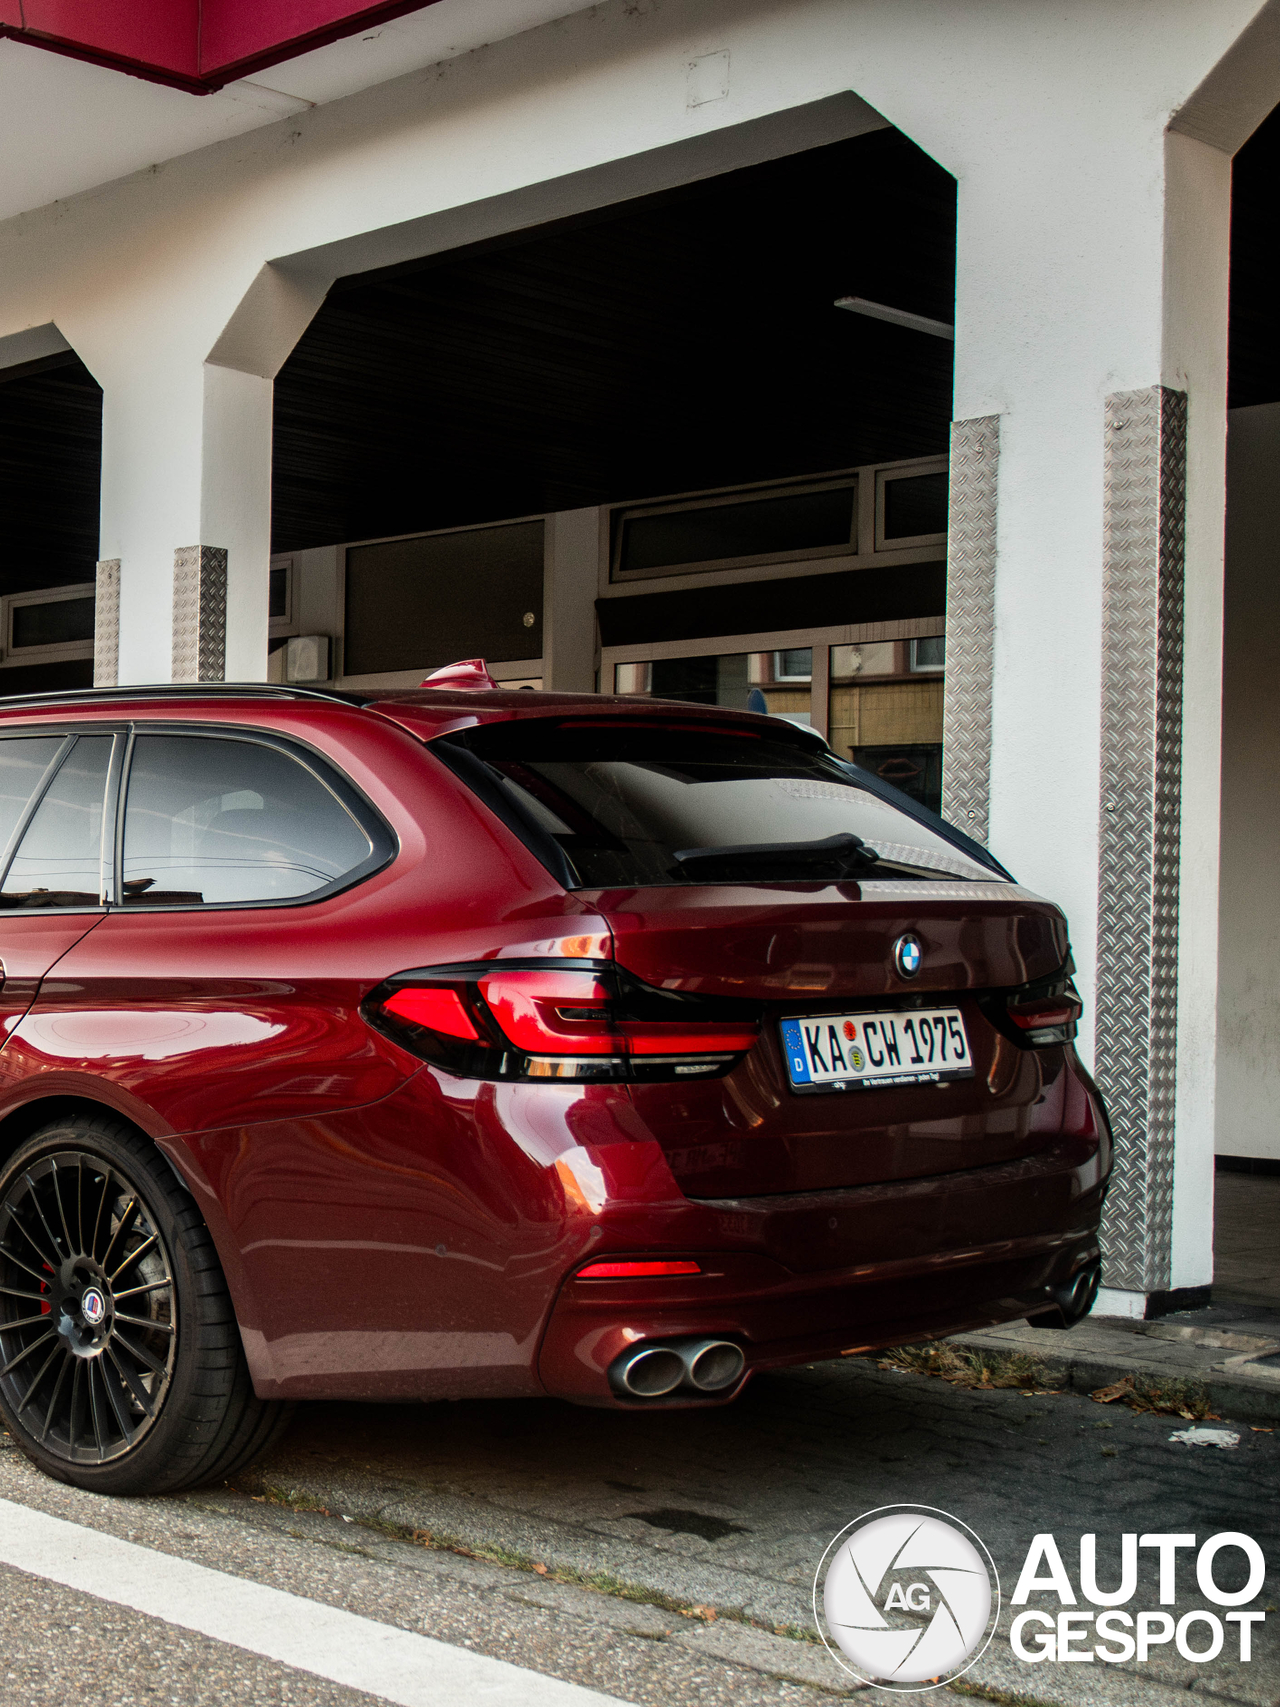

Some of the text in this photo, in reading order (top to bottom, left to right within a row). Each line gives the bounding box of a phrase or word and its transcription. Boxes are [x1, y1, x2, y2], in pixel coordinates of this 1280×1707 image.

[804, 1015, 966, 1074] KA CW 1975
[794, 1058, 804, 1072] D
